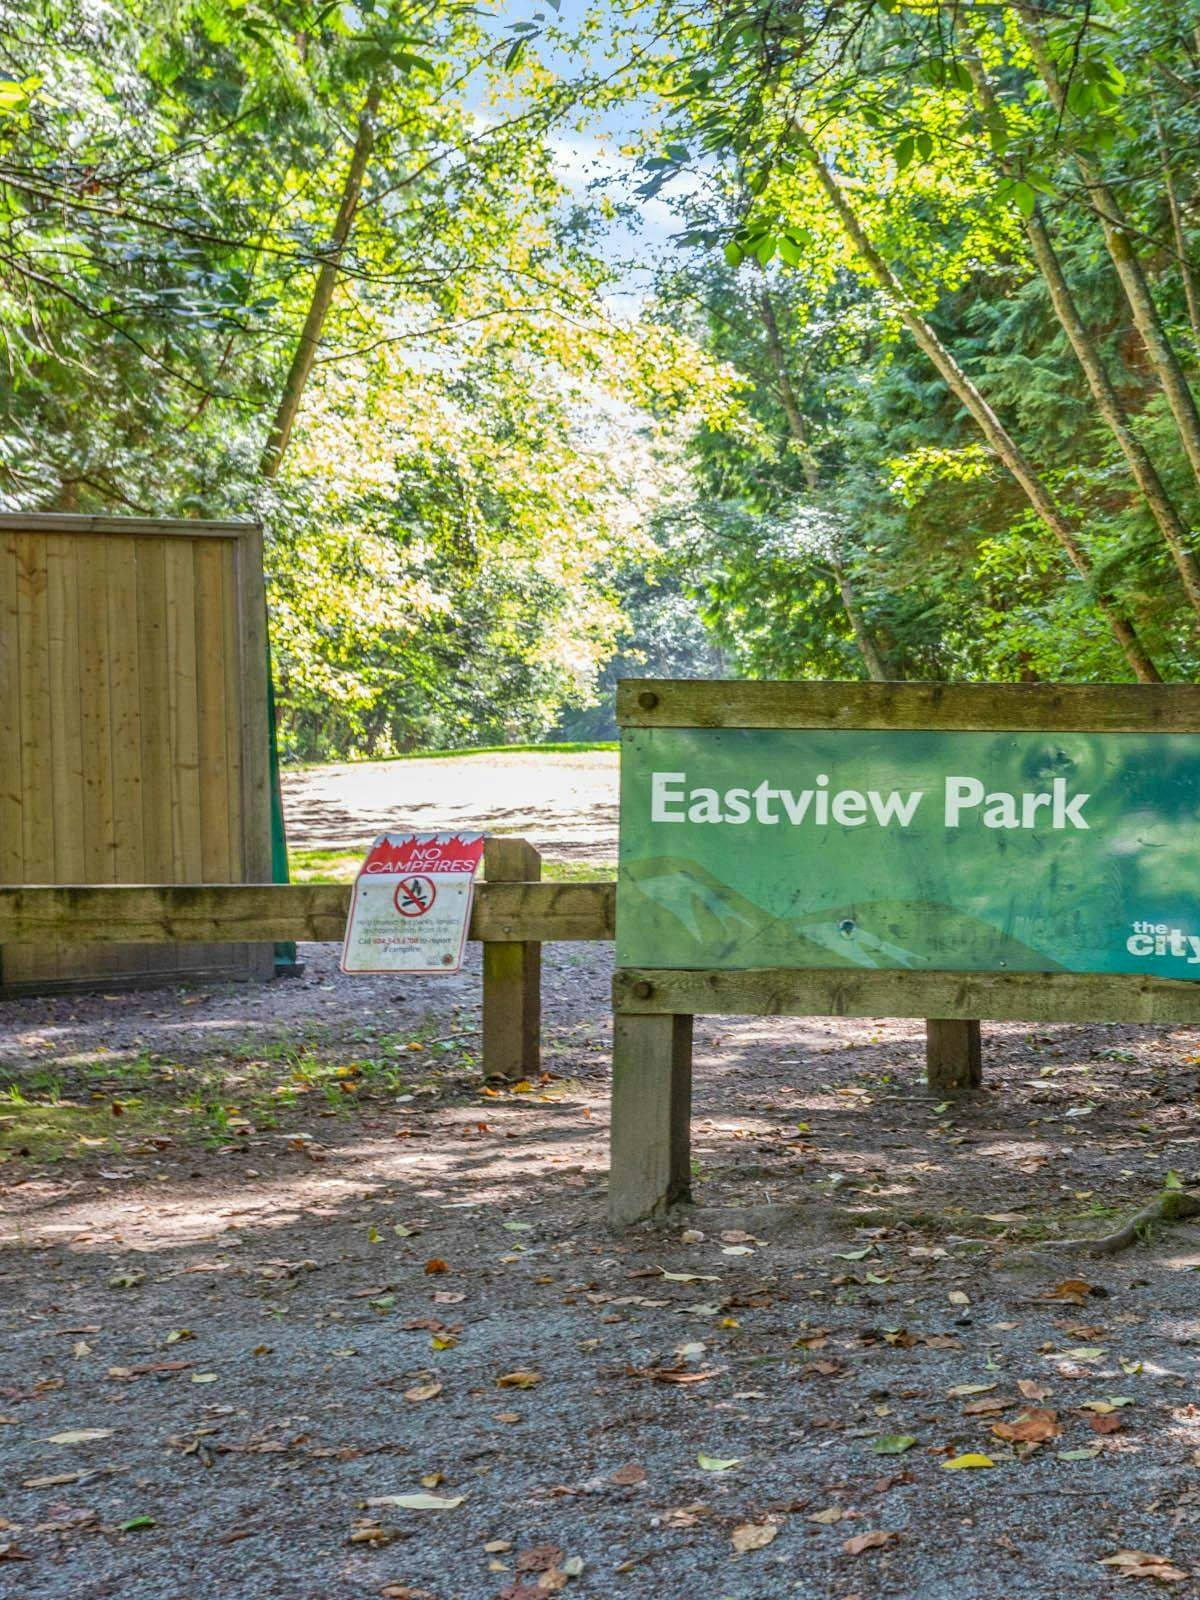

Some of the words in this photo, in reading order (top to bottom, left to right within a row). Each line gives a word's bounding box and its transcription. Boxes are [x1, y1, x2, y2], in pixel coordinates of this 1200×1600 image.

[651, 772, 922, 827] Eastview
[944, 776, 1090, 829] Park
[410, 848, 441, 859] NO
[366, 859, 475, 873] CAMPFIRES
[1132, 922, 1168, 934] the
